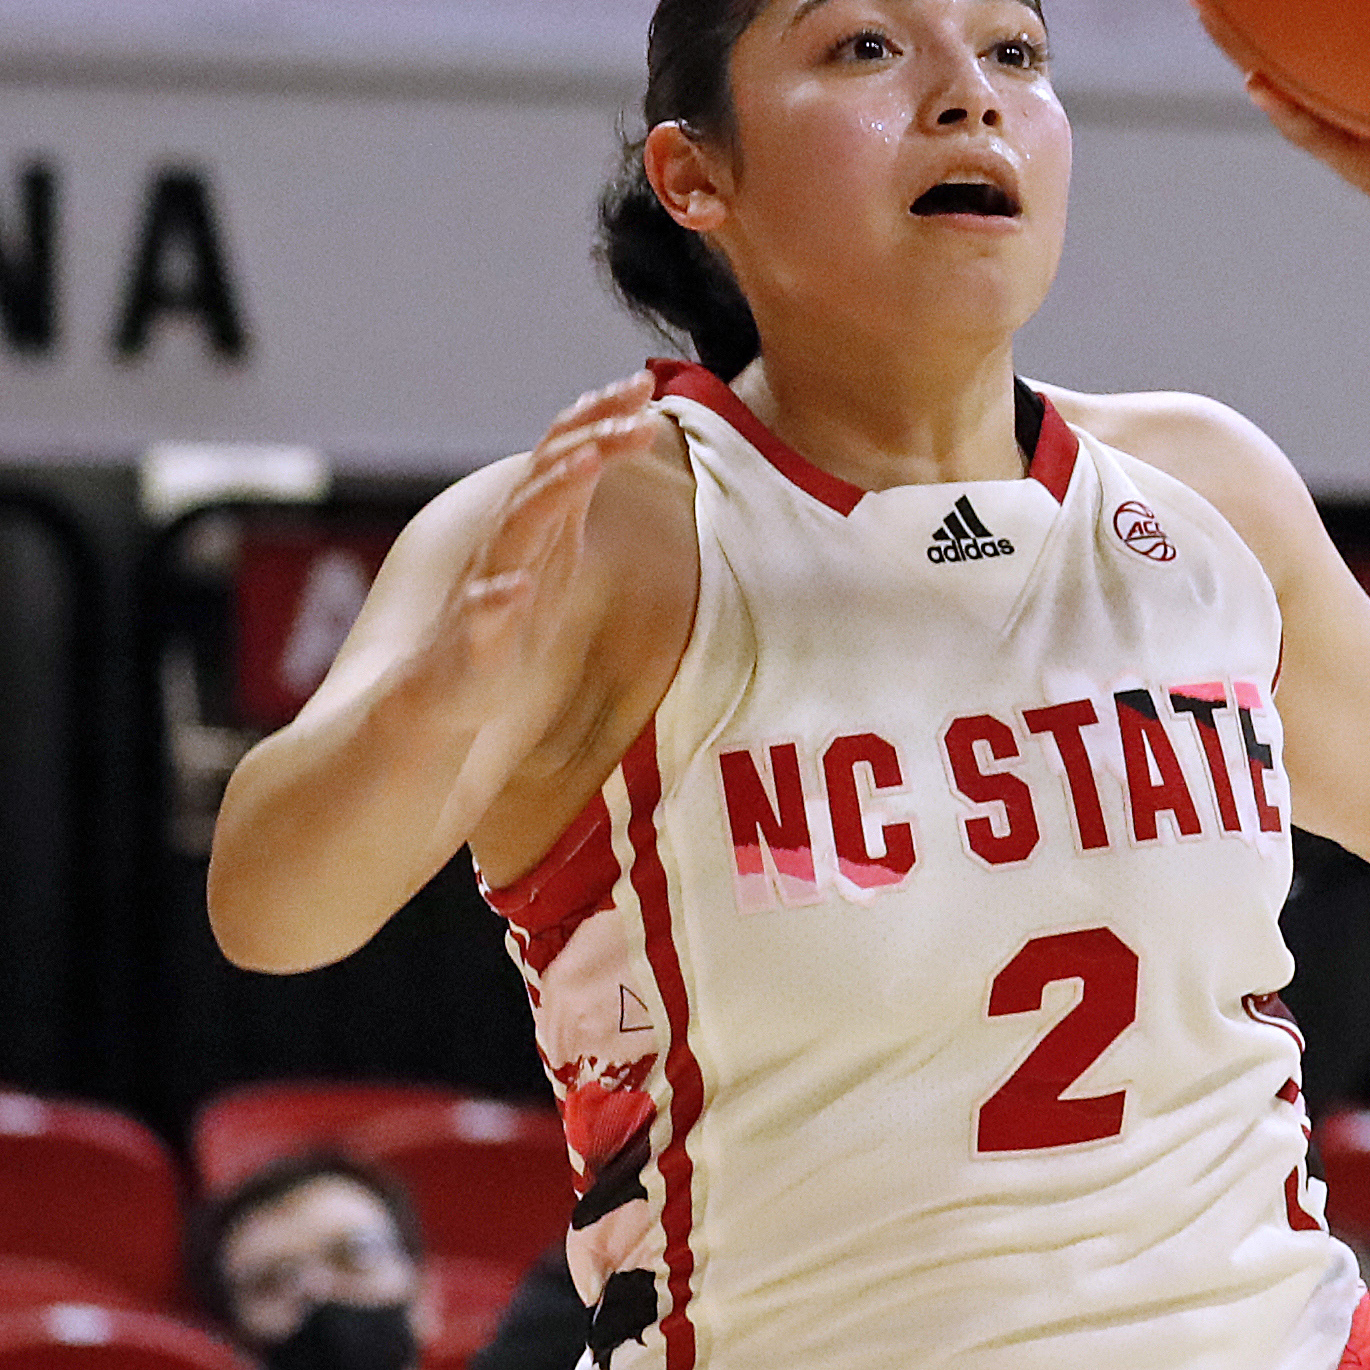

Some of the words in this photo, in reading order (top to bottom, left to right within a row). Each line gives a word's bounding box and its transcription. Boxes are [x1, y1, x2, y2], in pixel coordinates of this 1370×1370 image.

[927, 536, 1016, 564] adidas
[720, 732, 917, 912] NC
[945, 680, 1284, 866] STATE
[976, 926, 1140, 1154] 2
